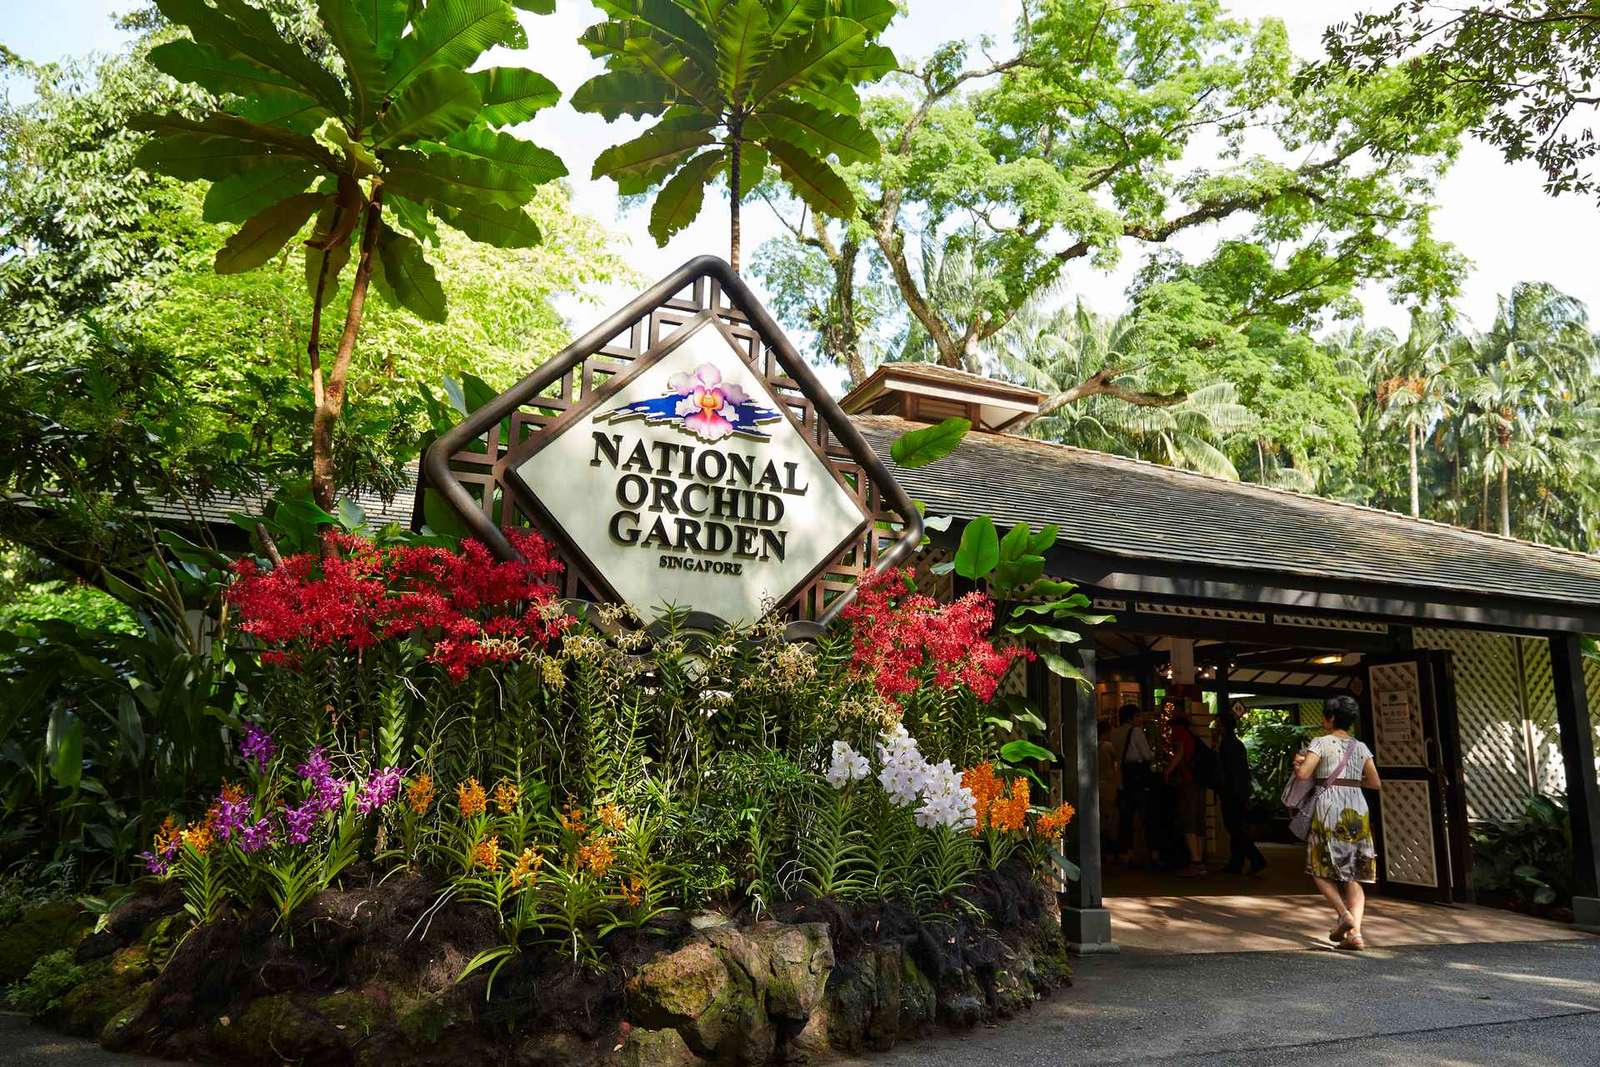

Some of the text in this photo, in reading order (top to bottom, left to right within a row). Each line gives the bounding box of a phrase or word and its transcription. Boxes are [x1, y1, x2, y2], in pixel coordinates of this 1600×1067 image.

[590, 431, 808, 496] NATIONAL
[615, 474, 785, 526] ORCHID
[608, 510, 788, 563] GARDEN
[659, 555, 742, 576] SINGAPORE
